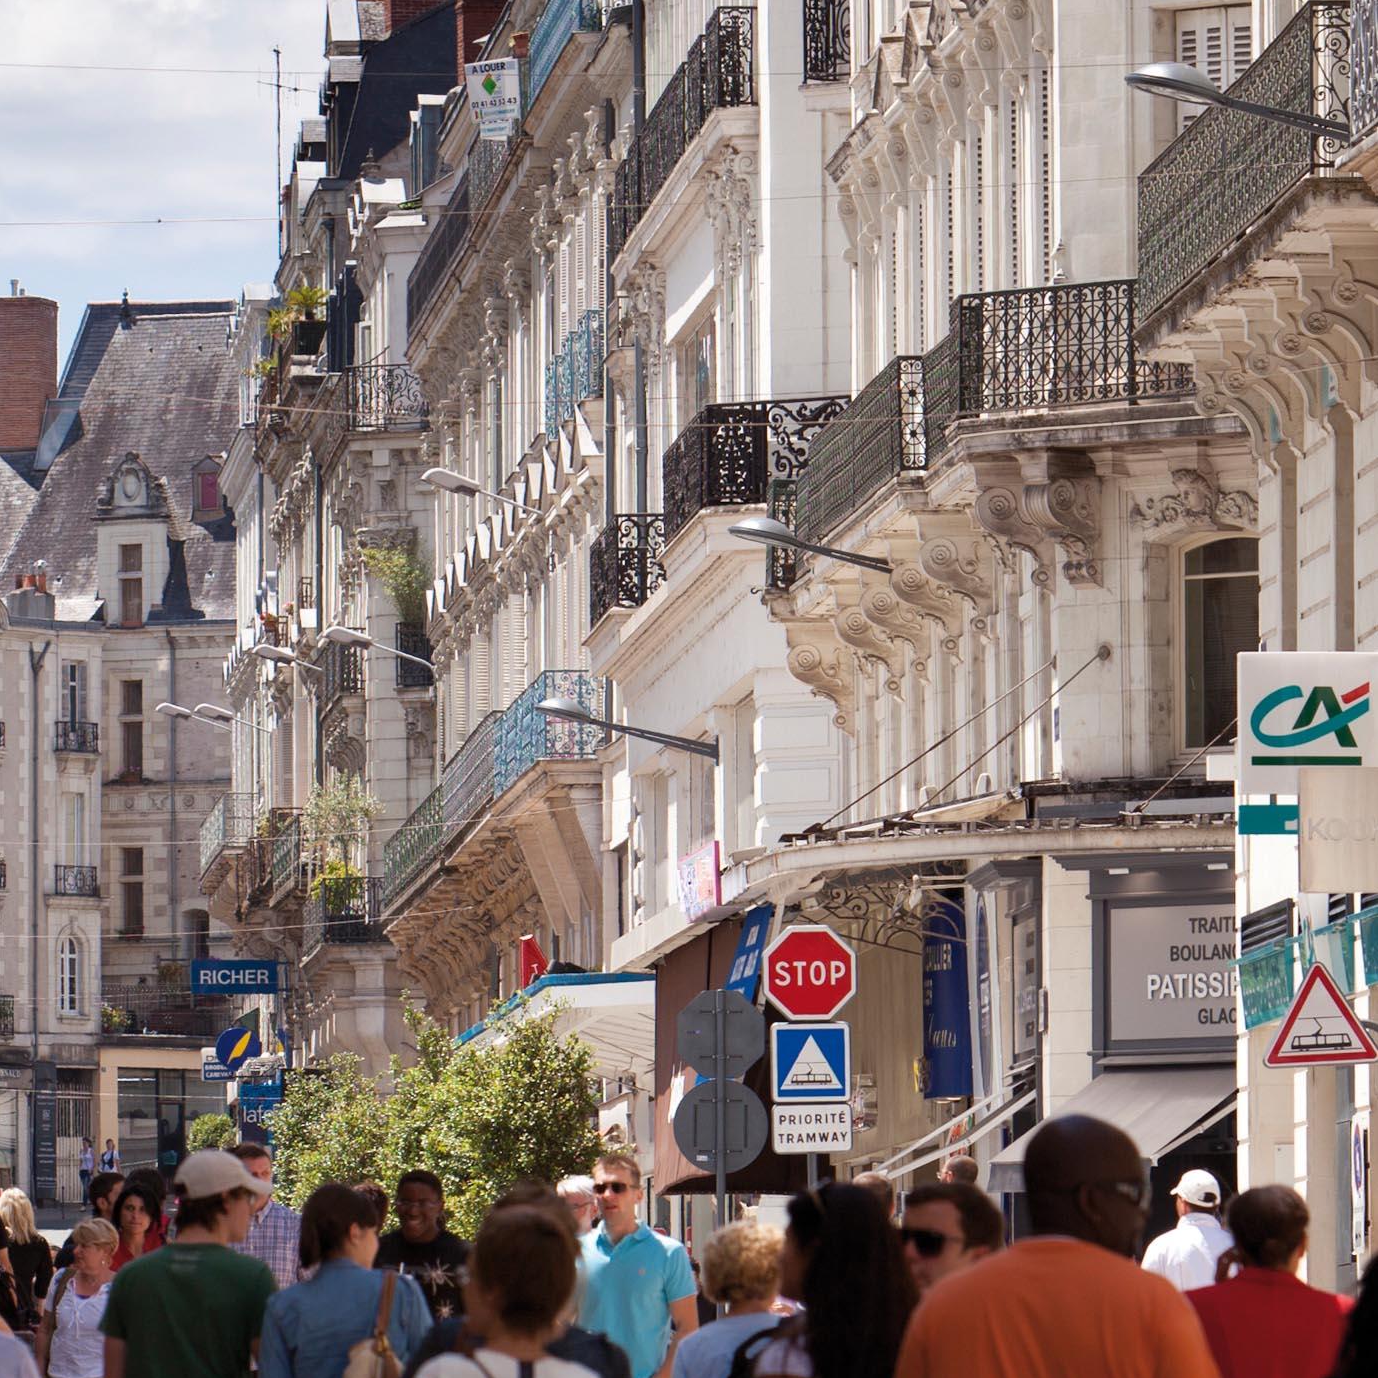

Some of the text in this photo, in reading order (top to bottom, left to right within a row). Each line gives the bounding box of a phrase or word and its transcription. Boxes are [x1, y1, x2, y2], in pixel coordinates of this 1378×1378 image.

[480, 62, 506, 73] LOUER
[1307, 816, 1378, 842] KOO
[199, 969, 270, 985] RICHER
[774, 960, 847, 986] STOP
[778, 1110, 847, 1125] PRIORITÉ
[778, 1131, 848, 1145] TRAMWAY
